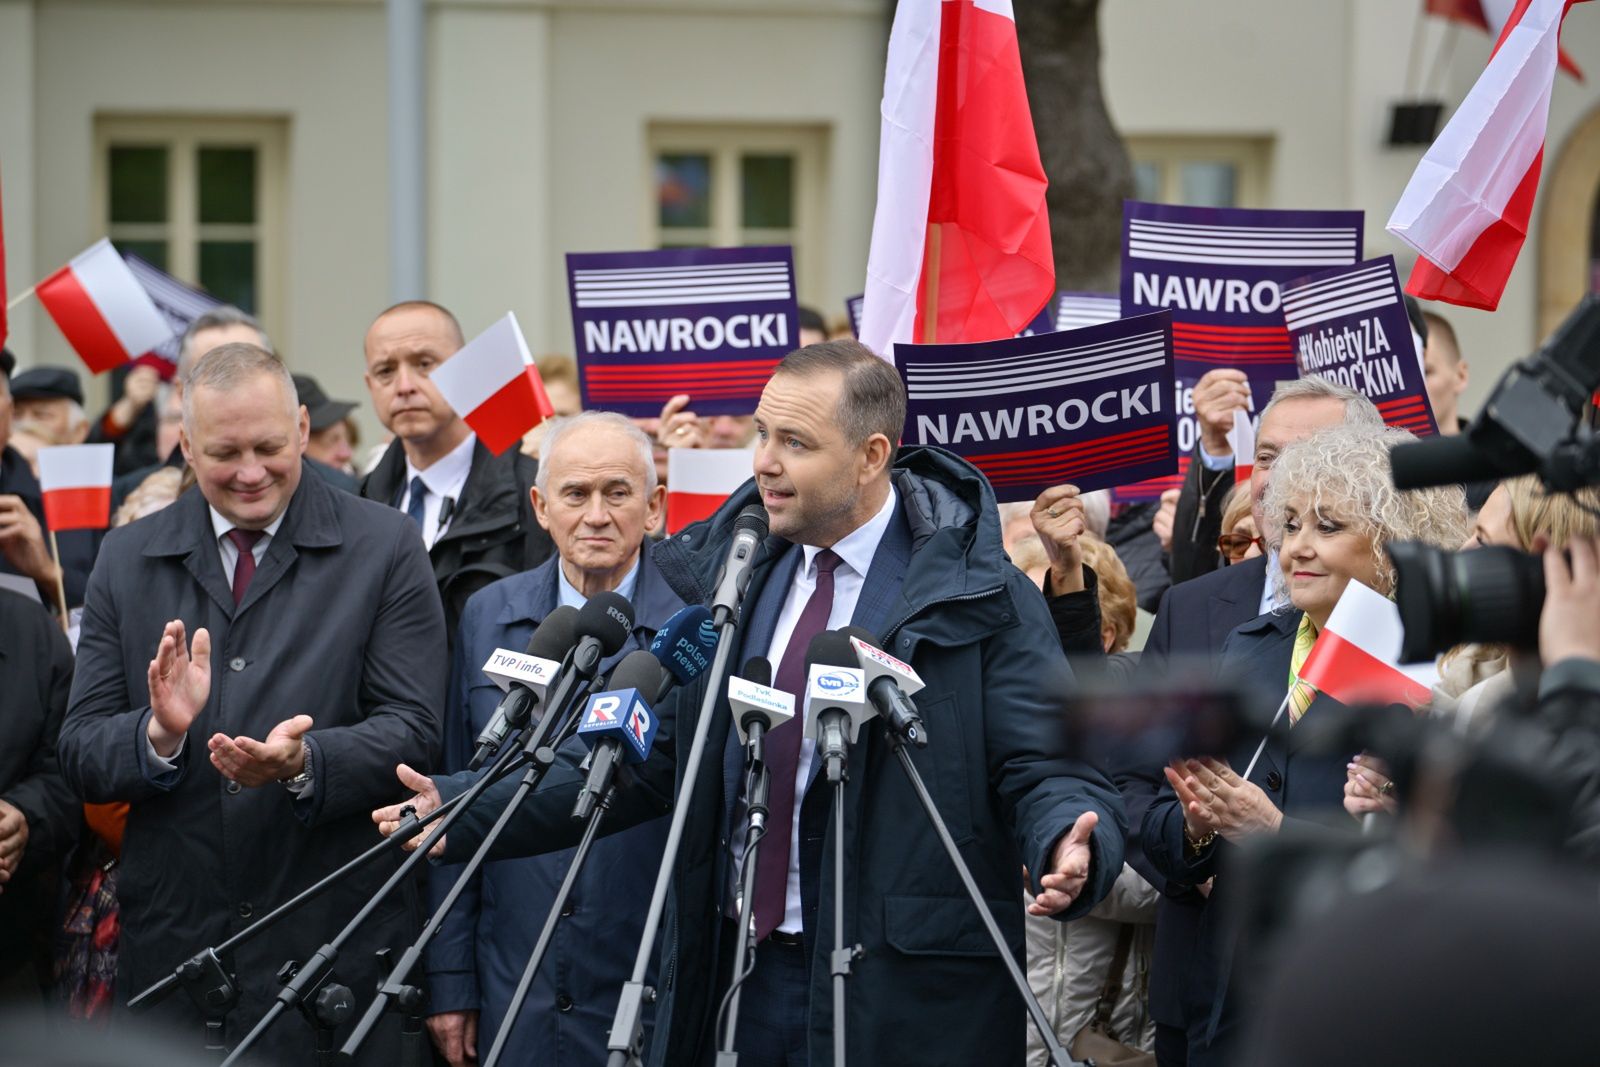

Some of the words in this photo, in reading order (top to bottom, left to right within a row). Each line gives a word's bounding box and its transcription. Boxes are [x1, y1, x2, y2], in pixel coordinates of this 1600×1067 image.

[1133, 271, 1281, 314] NAWRO
[583, 313, 789, 353] NAWROCKI
[1298, 316, 1391, 372] #KobietyZA
[1318, 355, 1405, 397] OCKIM
[916, 382, 1161, 445] NAWROCKI
[493, 654, 517, 668] TVP
[520, 660, 543, 675] info
[672, 650, 698, 676] news
